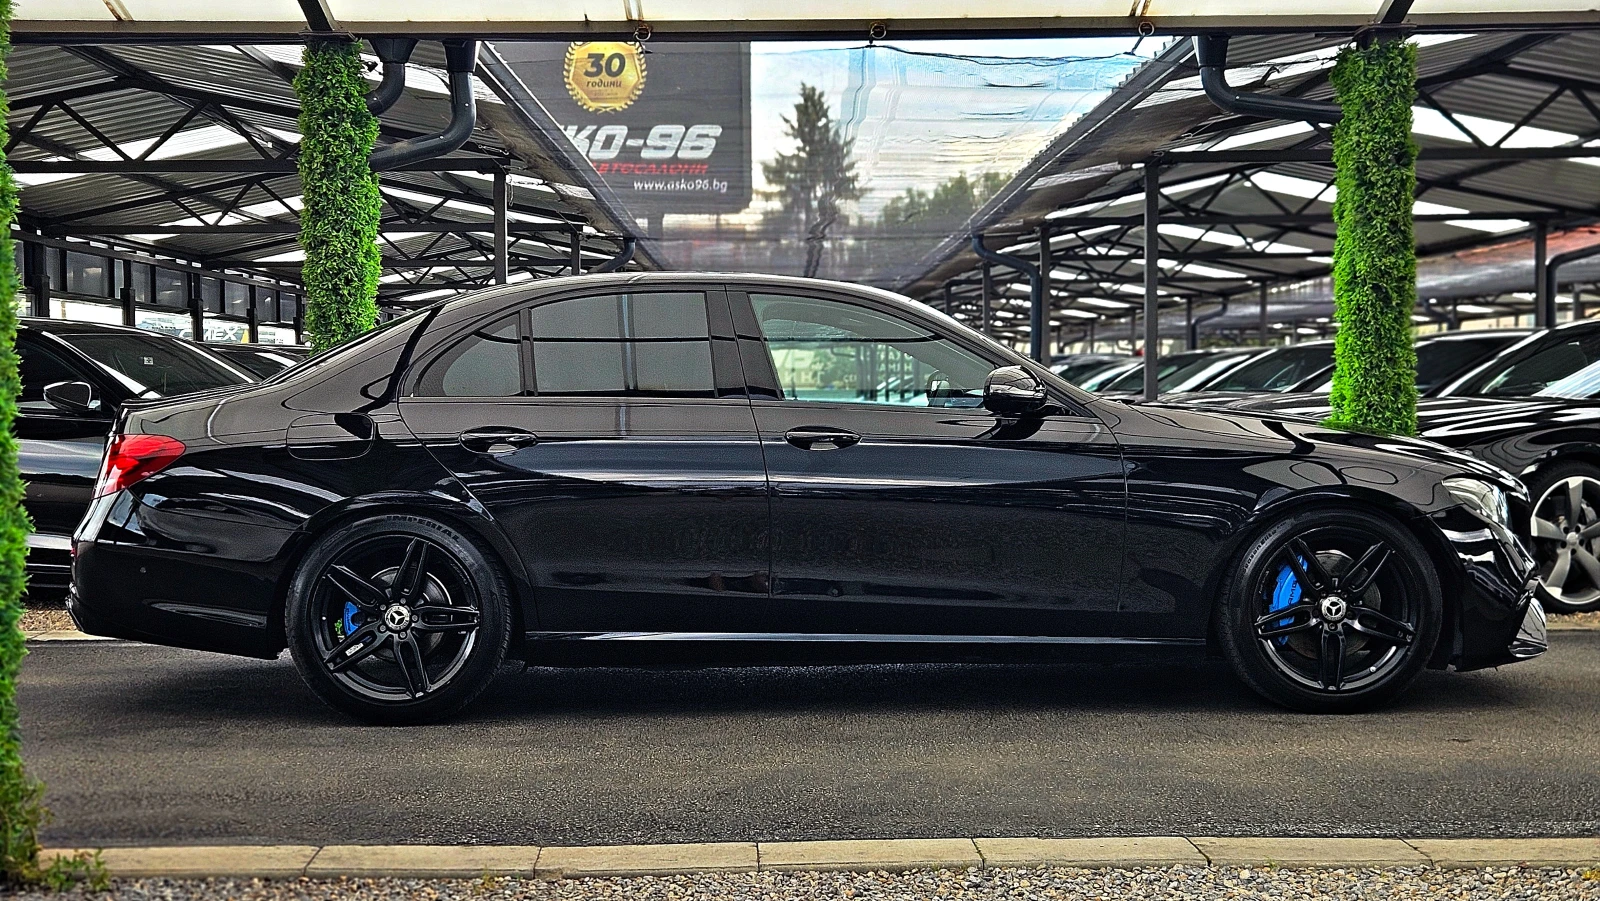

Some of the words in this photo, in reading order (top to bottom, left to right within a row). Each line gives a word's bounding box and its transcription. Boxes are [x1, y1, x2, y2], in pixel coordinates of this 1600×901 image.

[583, 52, 626, 78] 30
[633, 177, 728, 193] www.asko96.bg
[386, 514, 460, 543] IMPERIAL
